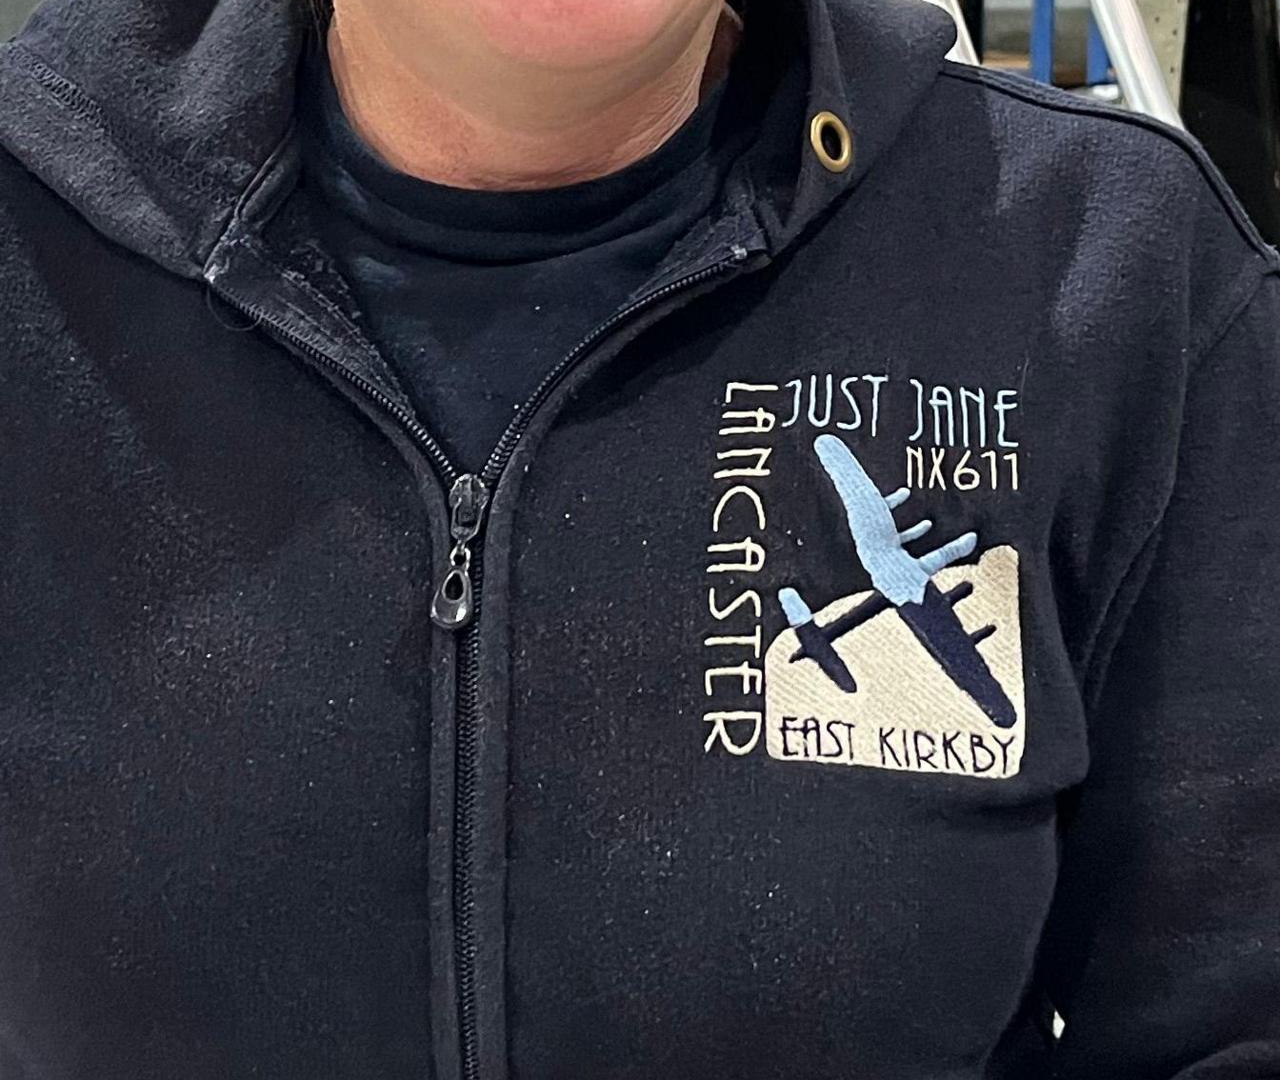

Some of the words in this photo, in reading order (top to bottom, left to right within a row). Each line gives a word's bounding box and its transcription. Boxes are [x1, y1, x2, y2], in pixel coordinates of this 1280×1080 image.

[782, 374, 888, 437] JUST
[908, 379, 1019, 448] JANE
[906, 446, 1019, 491] NX611
[703, 382, 778, 756] LANCASTER
[780, 716, 856, 760] EAST
[879, 727, 1017, 776] KIRKBY
